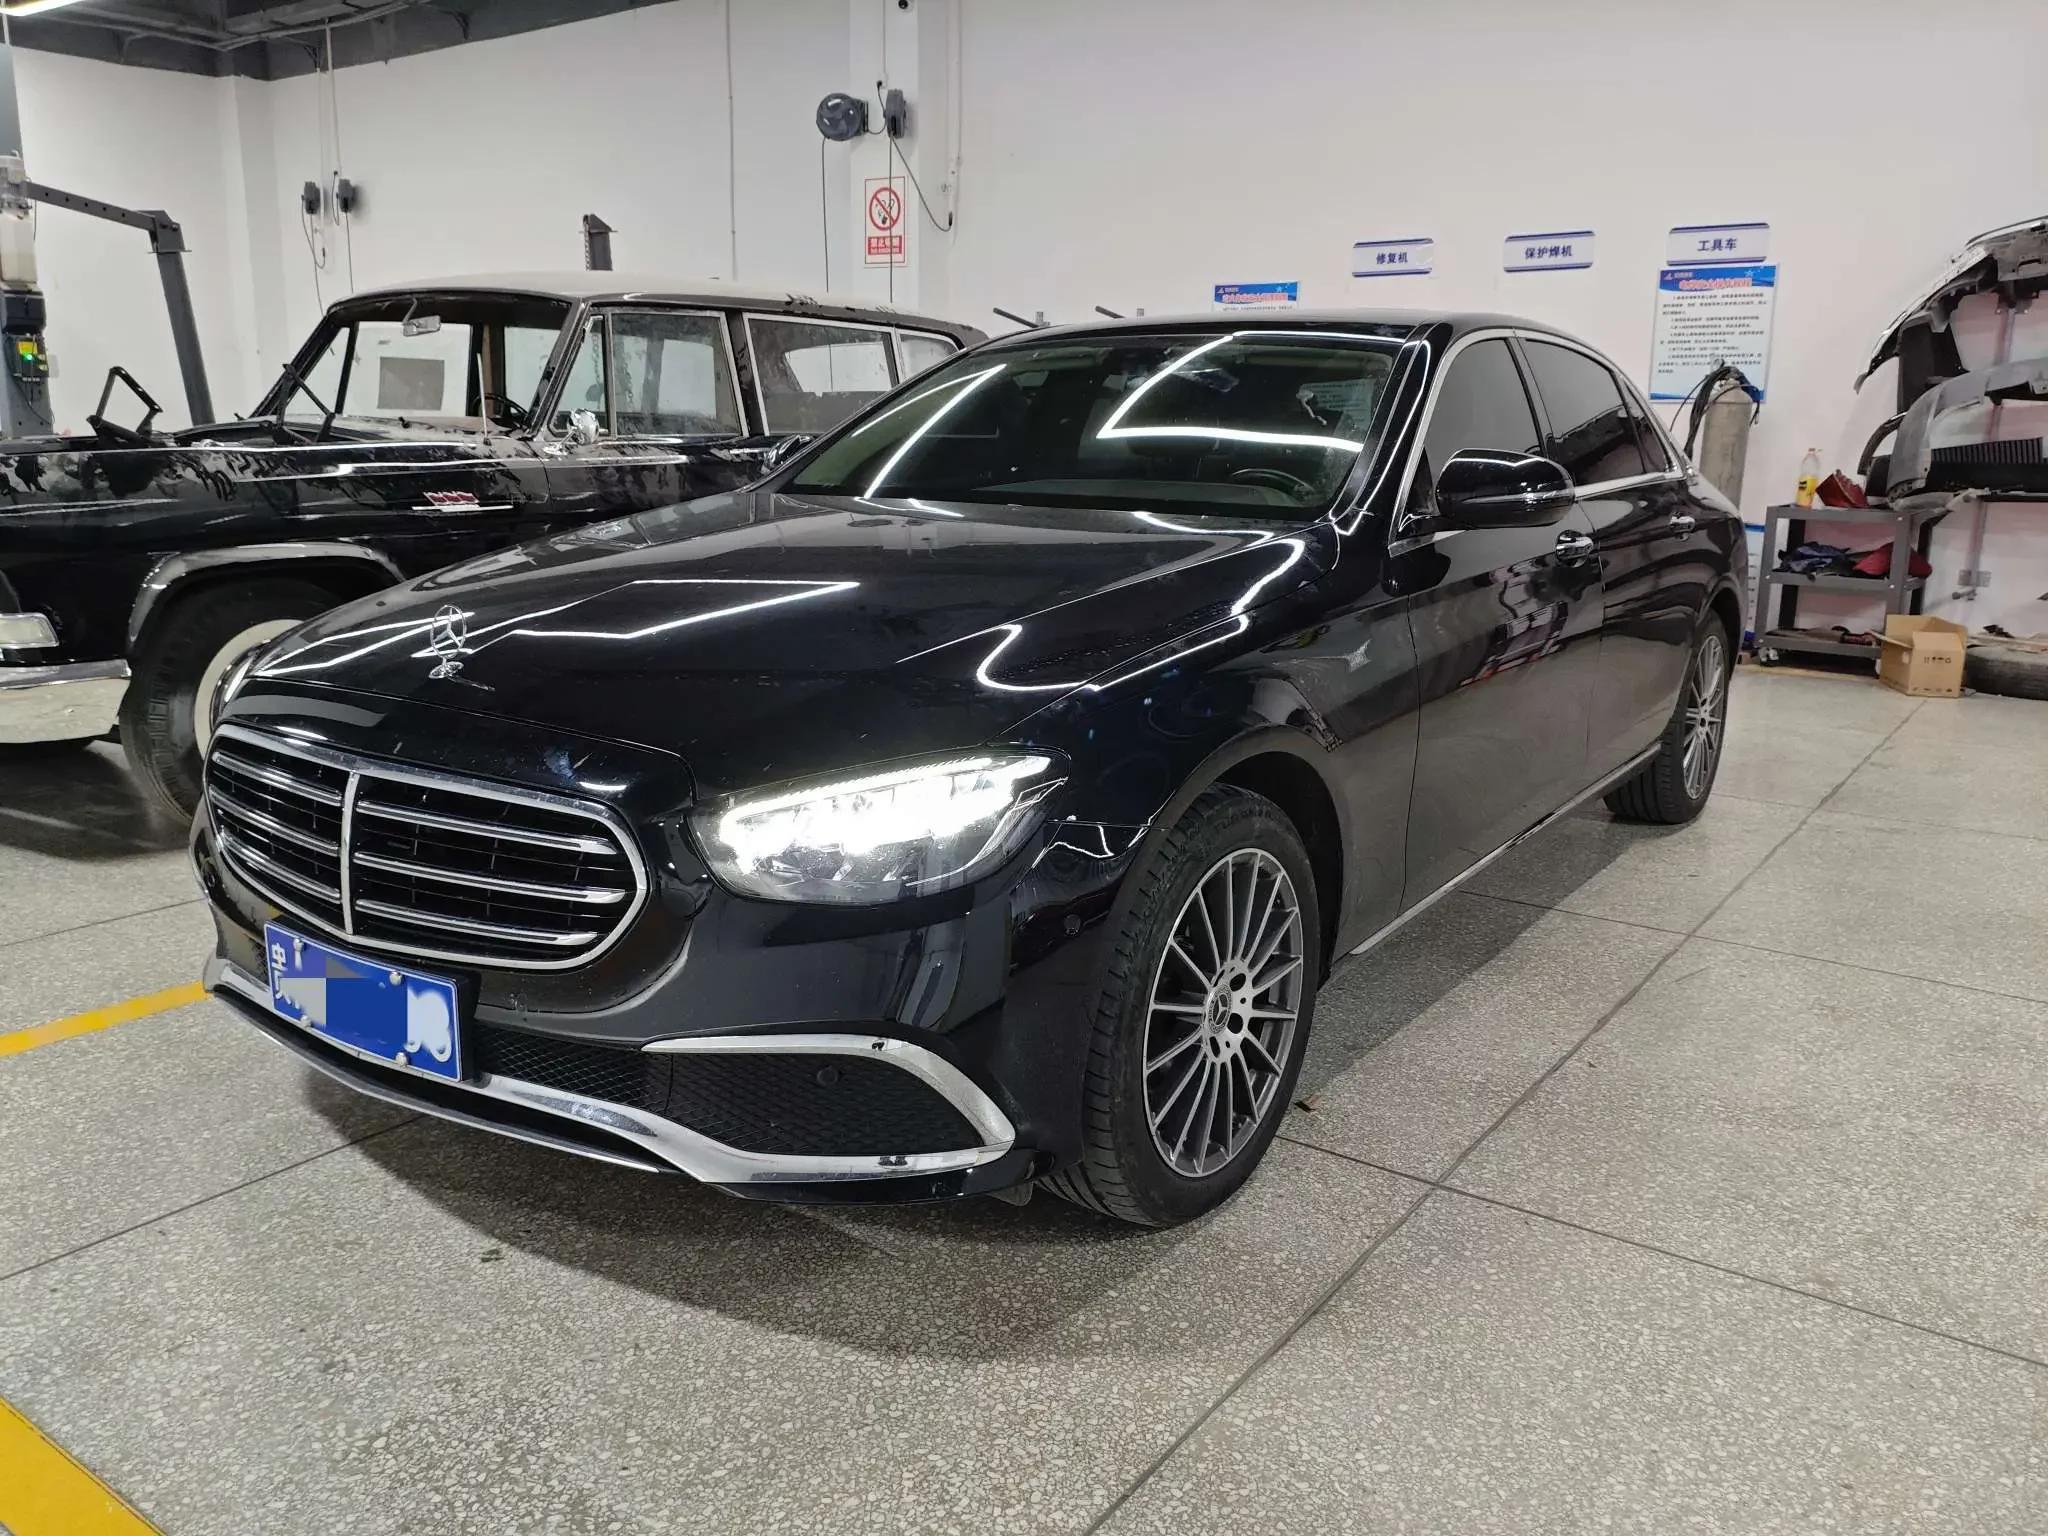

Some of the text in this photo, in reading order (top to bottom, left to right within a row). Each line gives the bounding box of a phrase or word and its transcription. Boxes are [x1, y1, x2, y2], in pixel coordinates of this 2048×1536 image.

[1697, 238, 1737, 251] 工具车
[1376, 252, 1408, 264] 修复机
[1525, 245, 1572, 259] 保护焊机
